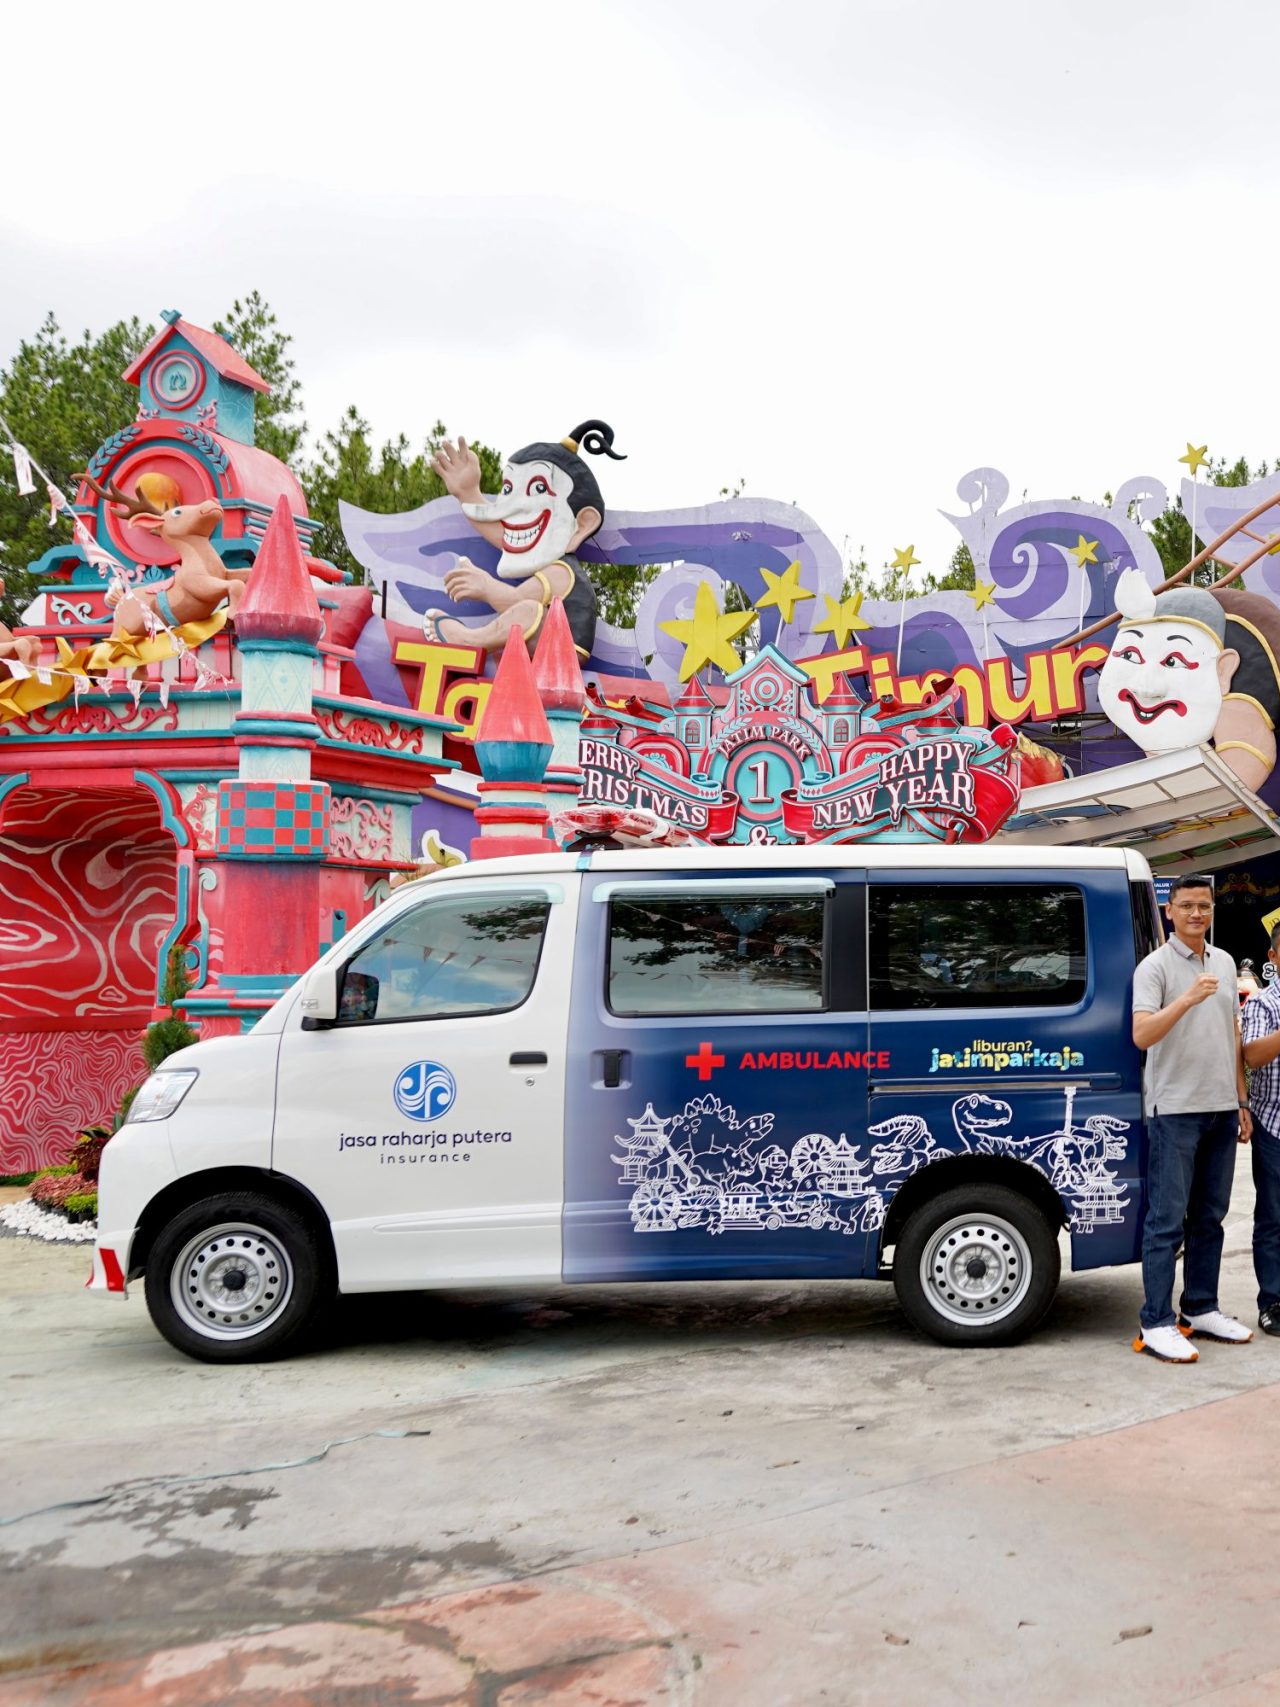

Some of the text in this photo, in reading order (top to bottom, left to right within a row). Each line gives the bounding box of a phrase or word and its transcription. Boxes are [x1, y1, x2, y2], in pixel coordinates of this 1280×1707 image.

[794, 643, 1111, 728] Timur
[580, 740, 638, 779] ERRY
[717, 725, 811, 761] JATIM PARK
[748, 760, 774, 803] 1
[880, 742, 973, 784] HAPPY
[578, 768, 707, 825] RISTMAS
[815, 788, 878, 826] NEW
[885, 772, 976, 822] YEAR
[739, 1051, 891, 1069] AMBULANCE
[929, 1046, 1084, 1072] jatimparkaja
[973, 1040, 1033, 1052] liburan?
[339, 1130, 512, 1151] jasa raharja putera
[380, 1153, 471, 1164] insurance
